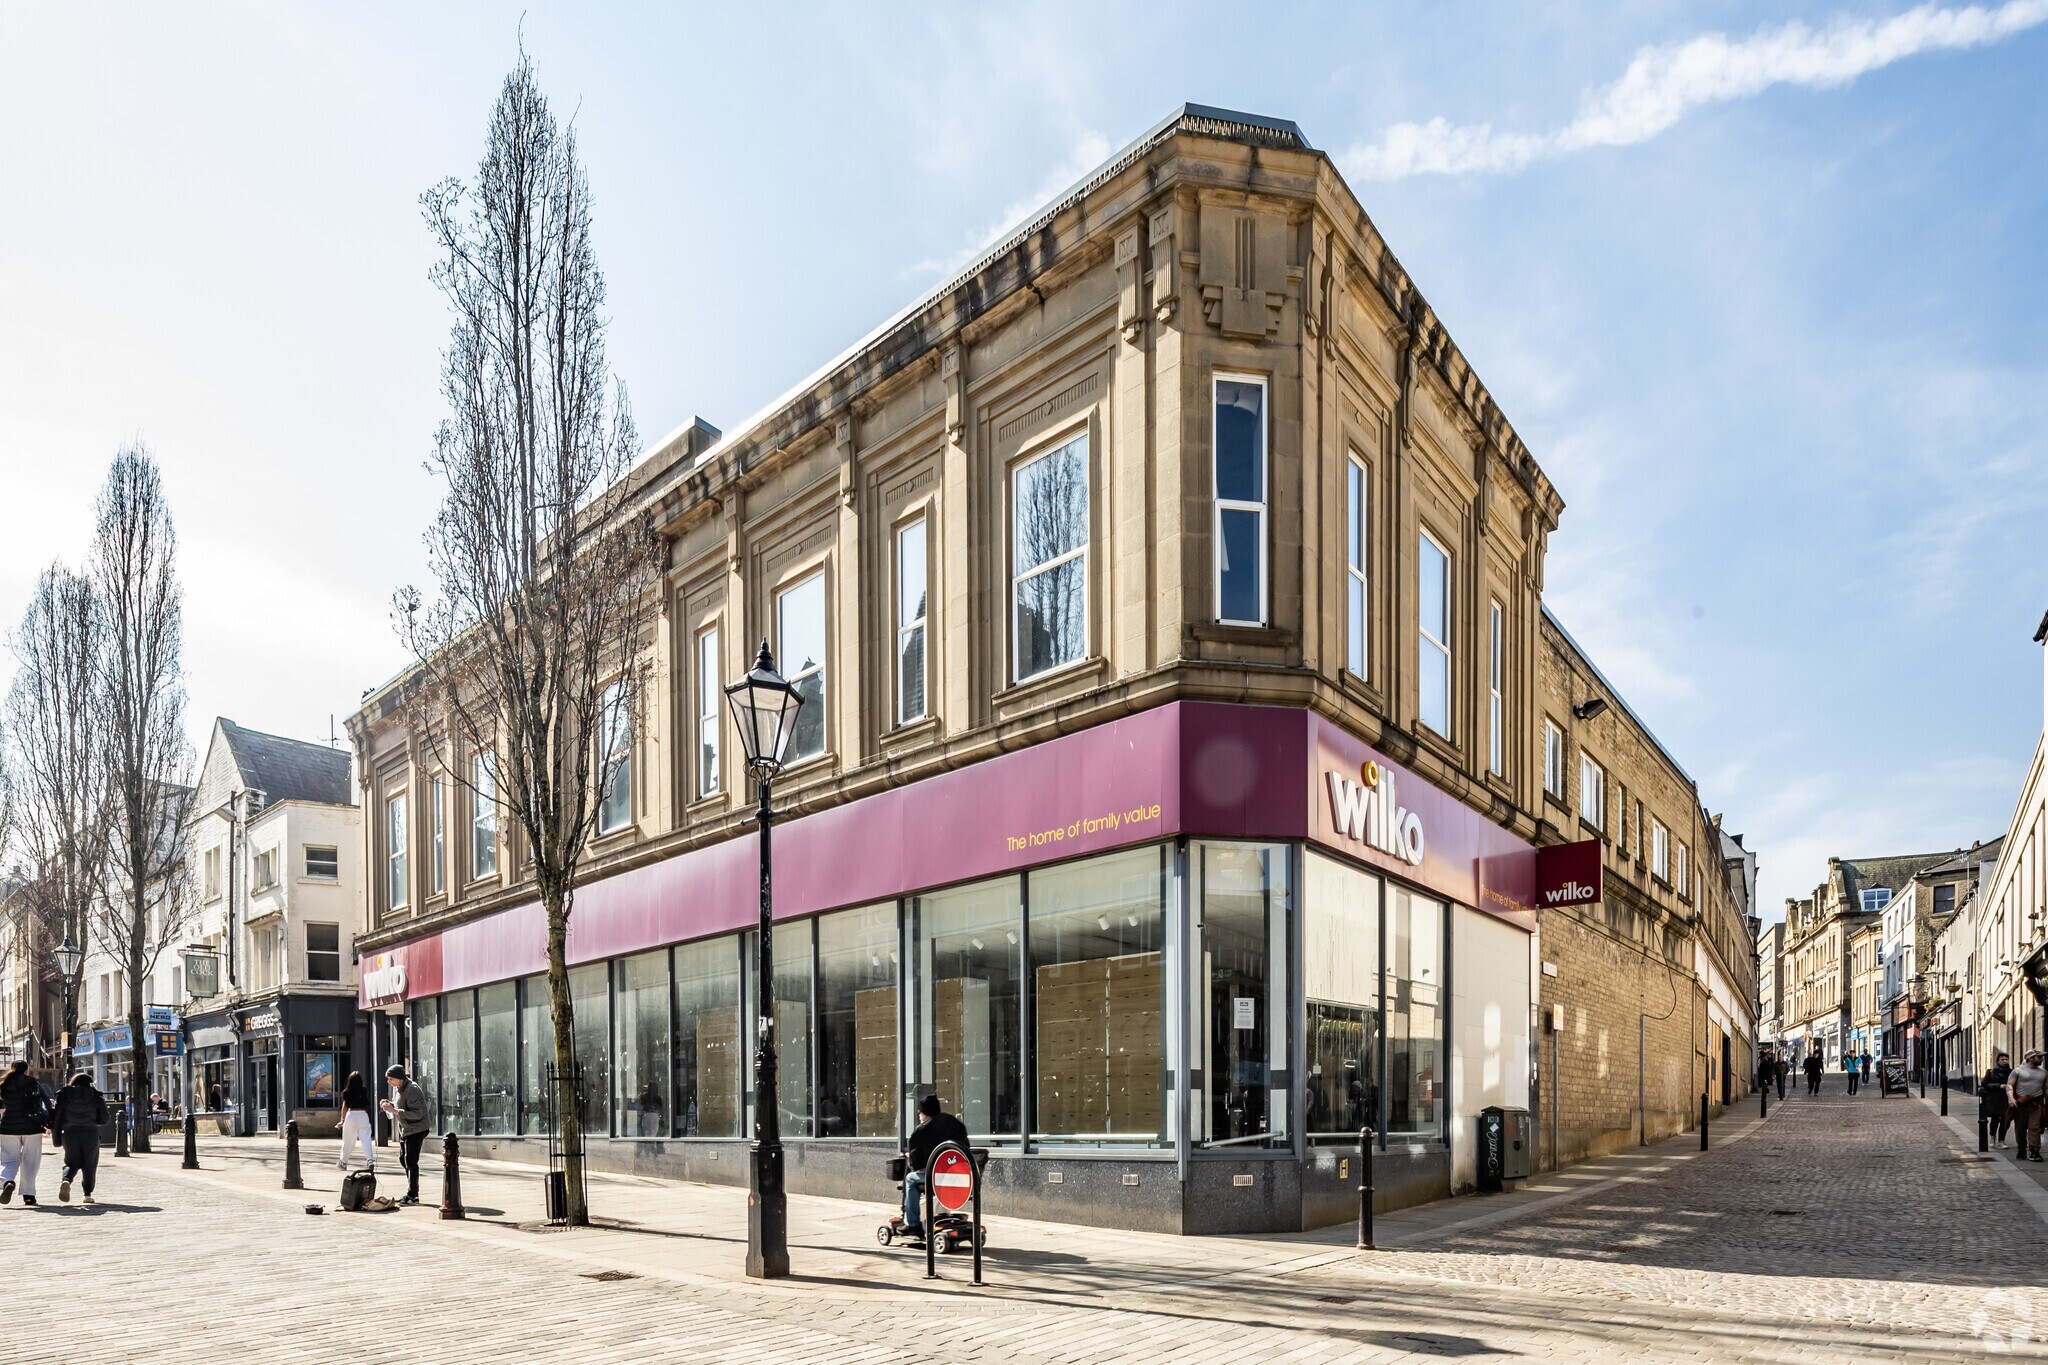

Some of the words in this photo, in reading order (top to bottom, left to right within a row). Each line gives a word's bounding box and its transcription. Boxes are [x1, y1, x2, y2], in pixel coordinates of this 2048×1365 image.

[1007, 837, 1026, 852] The
[1029, 828, 1064, 847] home
[1068, 820, 1080, 838] of
[1083, 812, 1121, 834] family
[1124, 804, 1161, 824] value
[1328, 760, 1424, 866] wilko
[1546, 881, 1594, 903] wilko
[190, 968, 214, 976] COCK
[364, 952, 407, 1000] wilko
[251, 1013, 275, 1030] GREGGS
